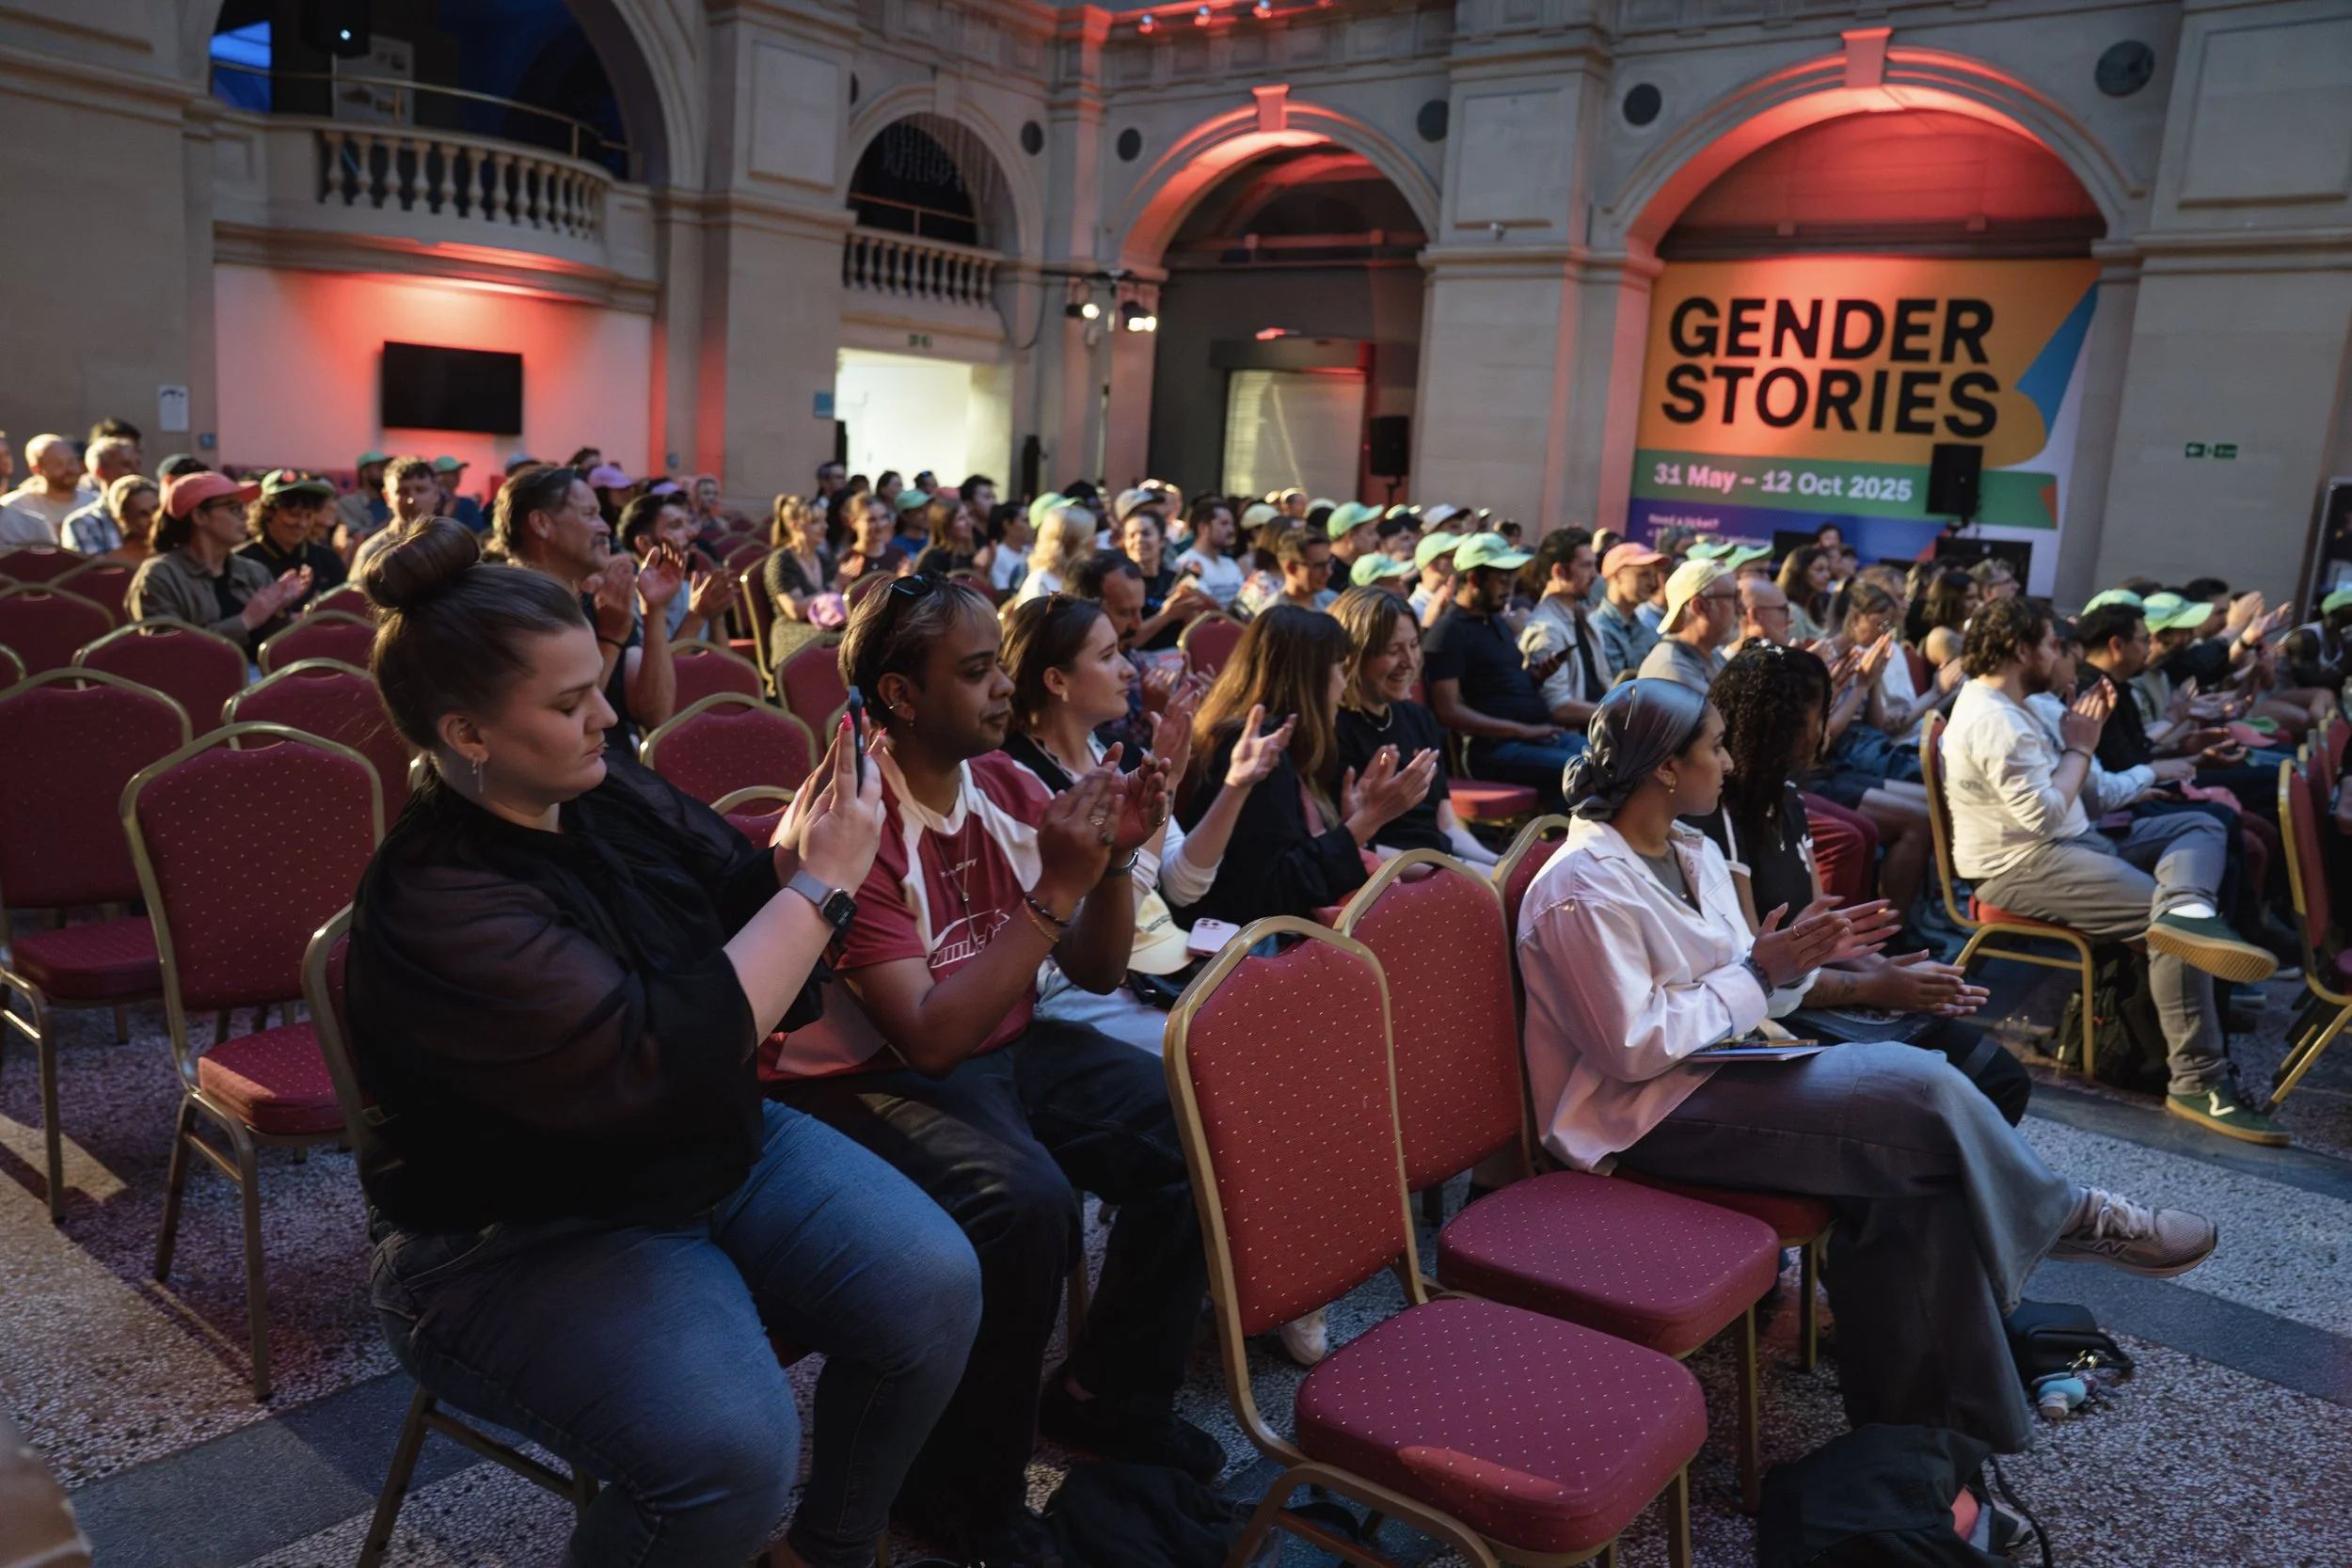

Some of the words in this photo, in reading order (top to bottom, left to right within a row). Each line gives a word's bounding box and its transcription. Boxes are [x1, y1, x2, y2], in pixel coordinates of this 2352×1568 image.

[1670, 297, 1994, 365] GENDER
[1661, 364, 2000, 438] STORIES
[1654, 462, 1682, 485] 31
[1688, 464, 1737, 494] May
[1760, 468, 1793, 494] 12
[1797, 471, 1843, 496] Oct
[1848, 474, 1913, 502] 2025
